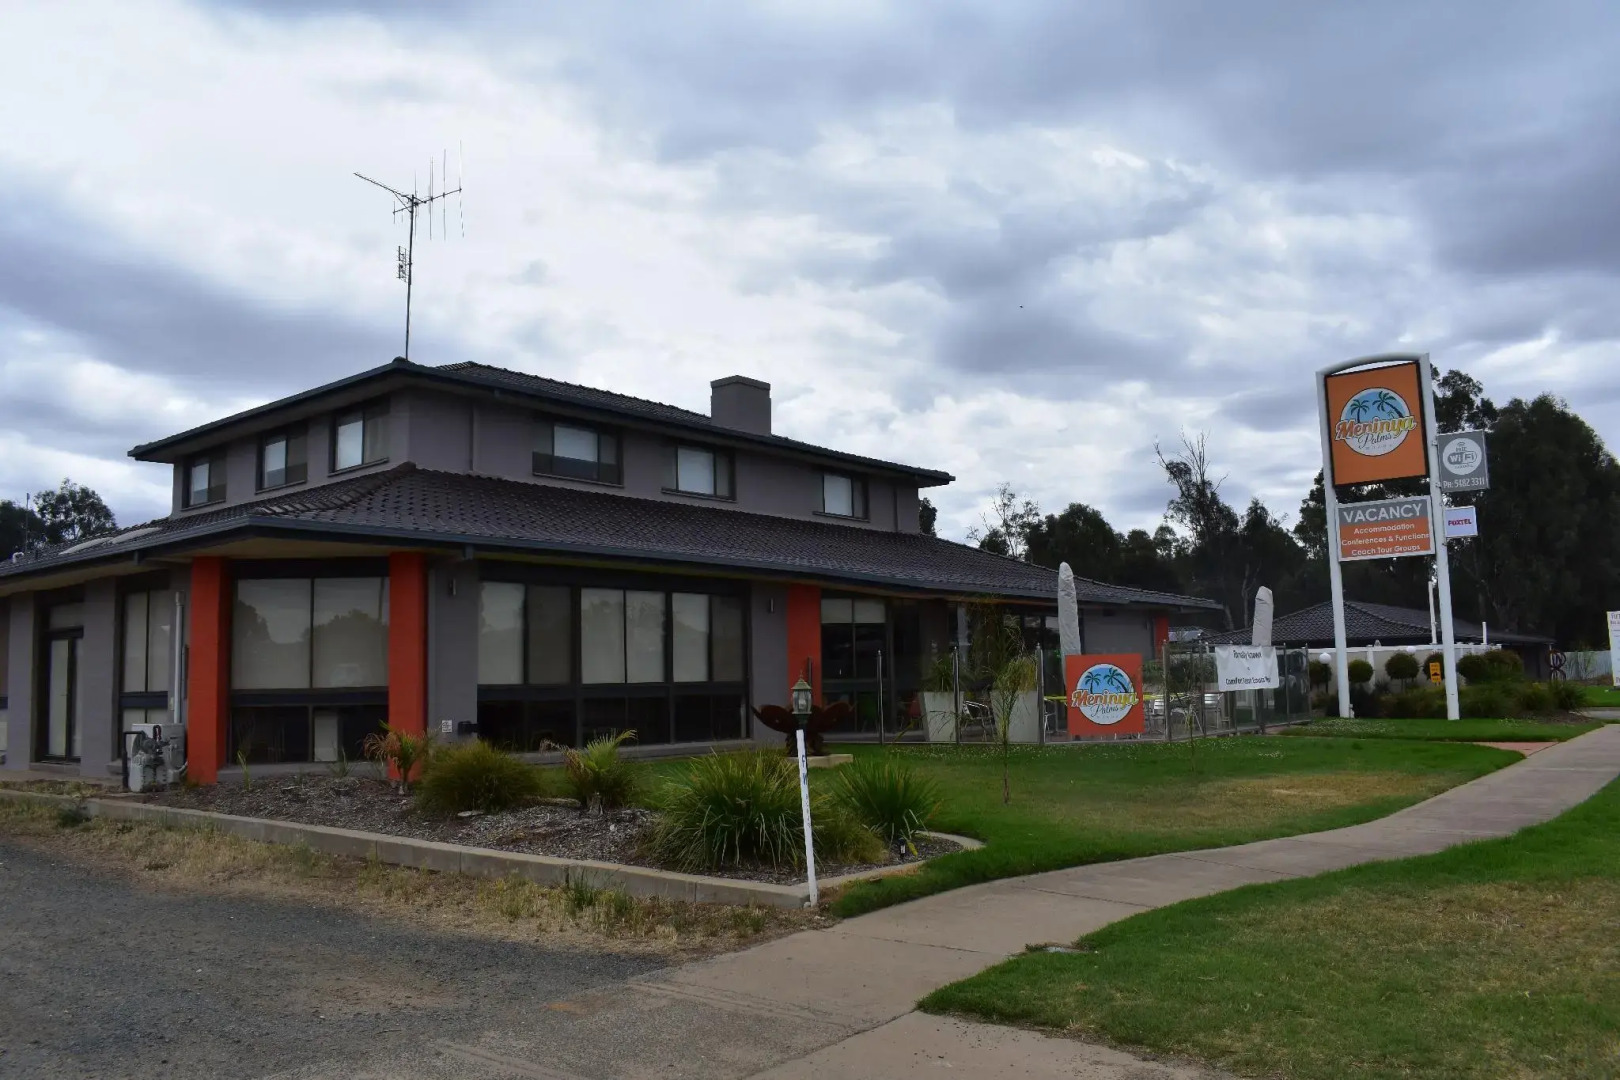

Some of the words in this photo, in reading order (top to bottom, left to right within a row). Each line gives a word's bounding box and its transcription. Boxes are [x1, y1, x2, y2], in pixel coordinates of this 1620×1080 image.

[1335, 416, 1417, 441] Meninya
[1358, 432, 1392, 449] Palms
[1343, 503, 1422, 523] VACANCY
[1354, 523, 1415, 534] Accommodation
[1342, 538, 1386, 546] Conferences
[1396, 533, 1430, 541] Functions
[1071, 689, 1139, 710] Meninya
[1090, 704, 1119, 717] Palms
